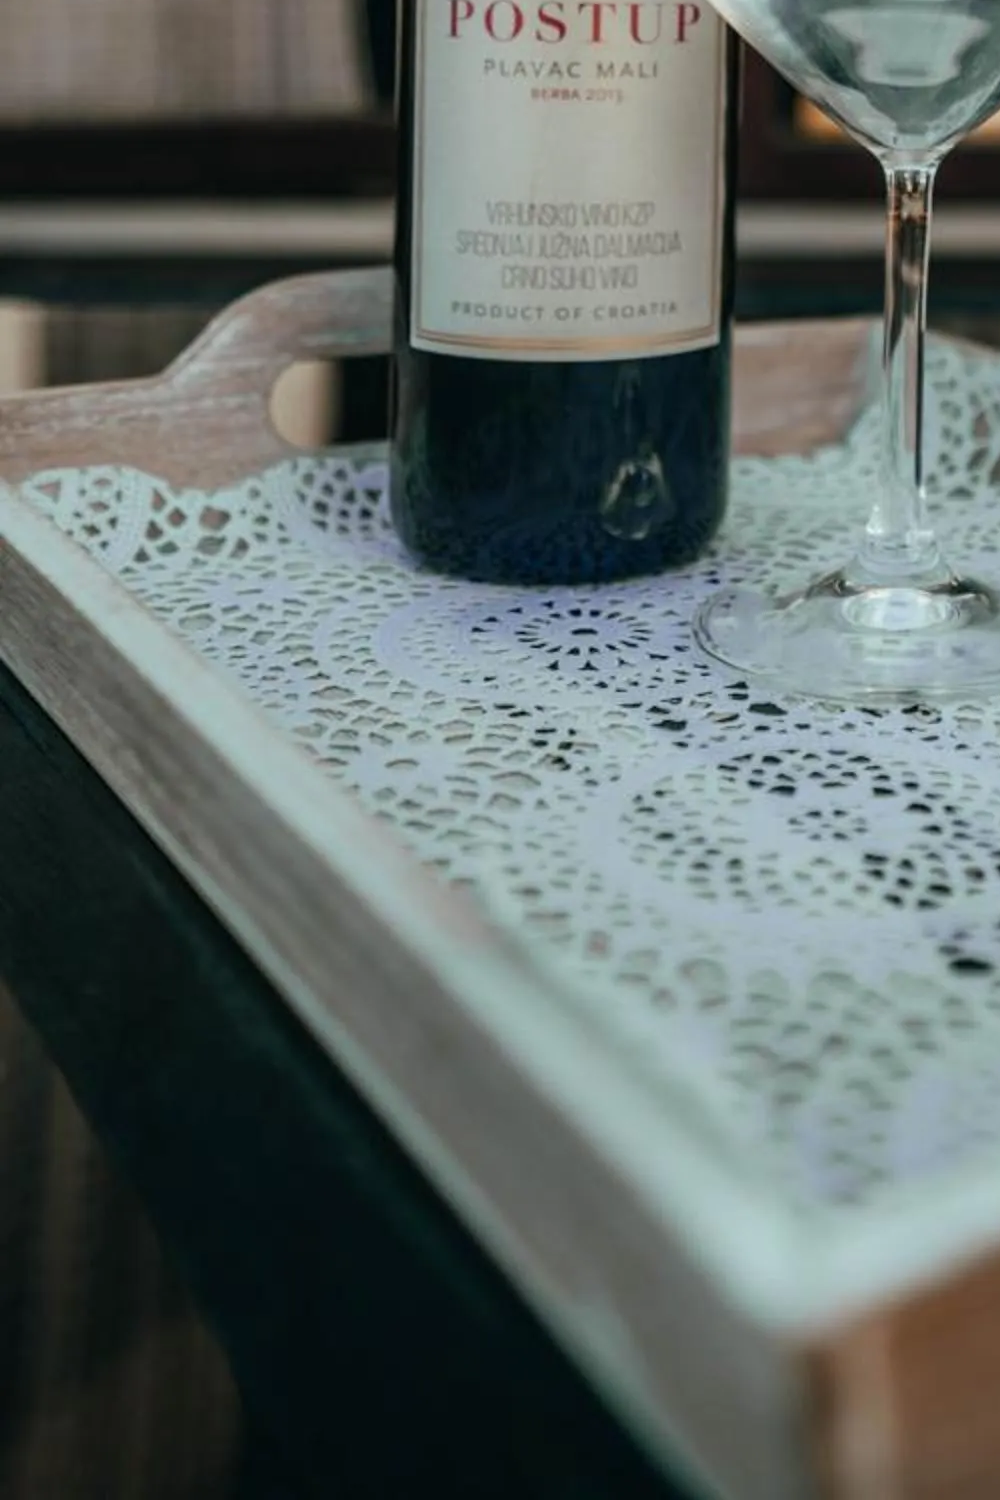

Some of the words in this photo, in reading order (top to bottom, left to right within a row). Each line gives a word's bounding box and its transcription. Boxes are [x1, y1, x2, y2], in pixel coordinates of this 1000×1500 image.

[484, 59, 581, 79] PLAVAC
[596, 61, 658, 79] MALI
[531, 87, 580, 101] BERBA
[451, 300, 545, 320] PRODUCT
[554, 306, 584, 321] OF
[592, 301, 679, 320] CROATIA
